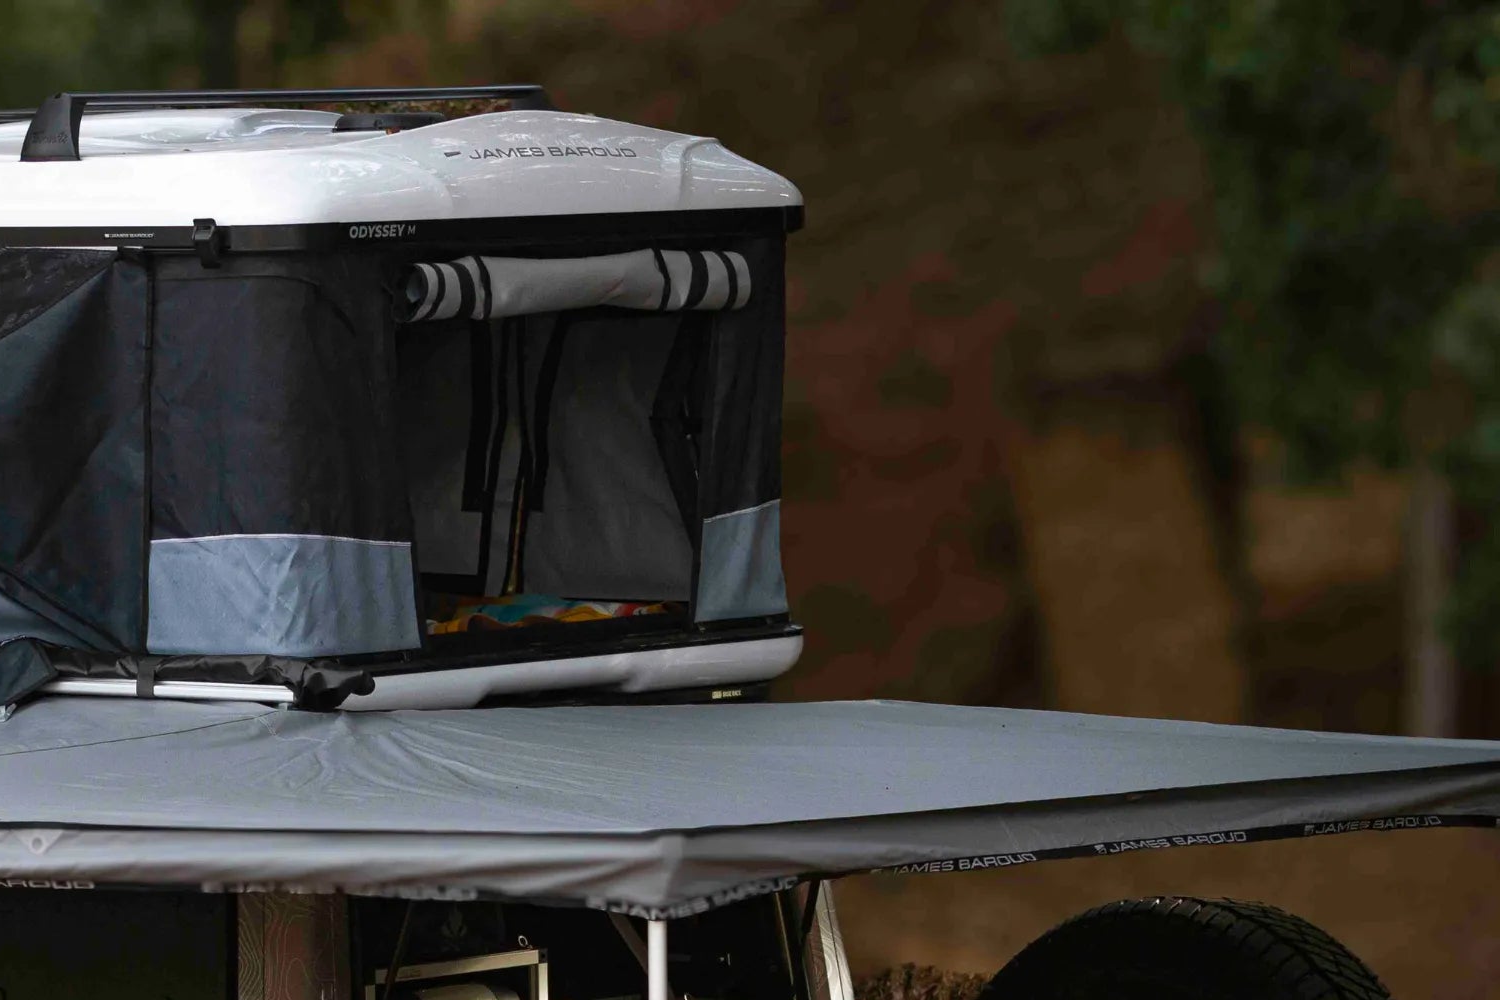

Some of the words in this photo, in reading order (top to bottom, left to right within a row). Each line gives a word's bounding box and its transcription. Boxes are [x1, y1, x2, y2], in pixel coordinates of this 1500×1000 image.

[469, 147, 545, 160] JAMES
[548, 146, 637, 158] BAROUD
[349, 224, 405, 239] ODYSSEY
[407, 225, 417, 235] M
[1315, 821, 1371, 836] JAMES
[1374, 815, 1442, 830] BAROUD
[1109, 837, 1171, 855] JAMES
[1173, 830, 1247, 846] BAROUD
[958, 852, 1037, 871] BAROUD
